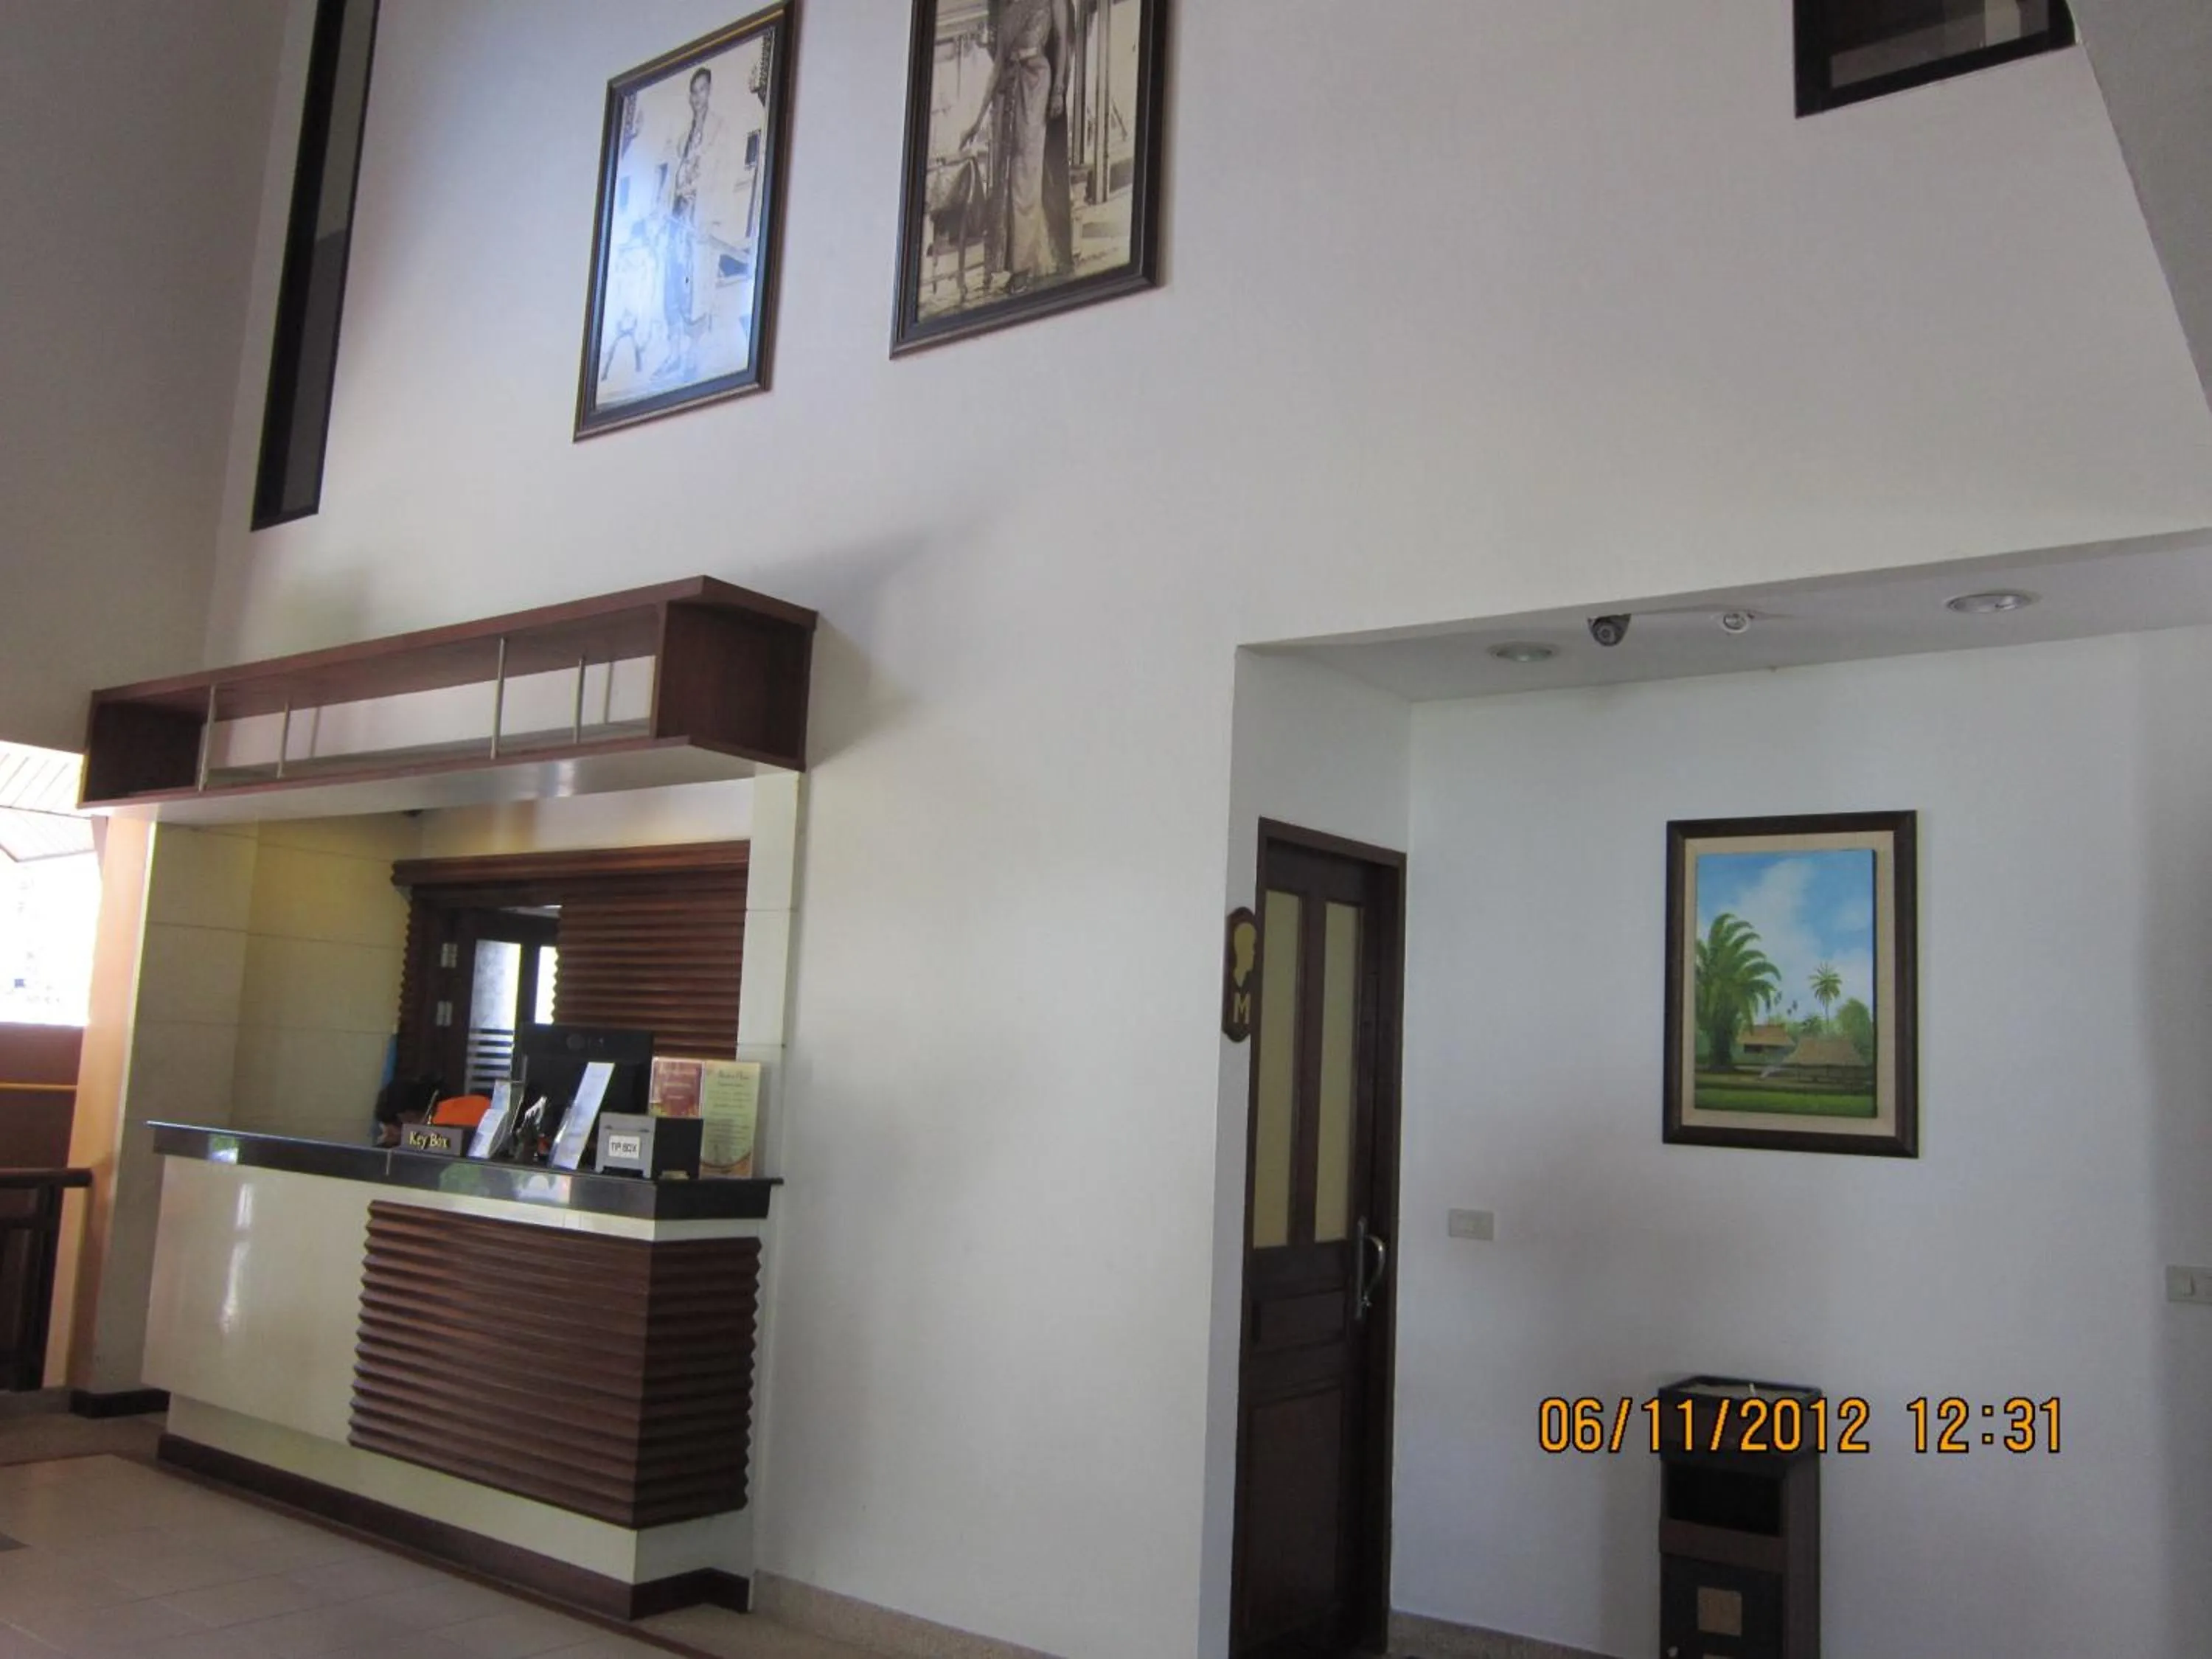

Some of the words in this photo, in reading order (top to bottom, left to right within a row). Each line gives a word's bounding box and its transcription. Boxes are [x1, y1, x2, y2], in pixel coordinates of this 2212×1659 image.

[1233, 992, 1251, 1025] M
[409, 1131, 428, 1150] Key
[611, 1141, 622, 1152] TIP
